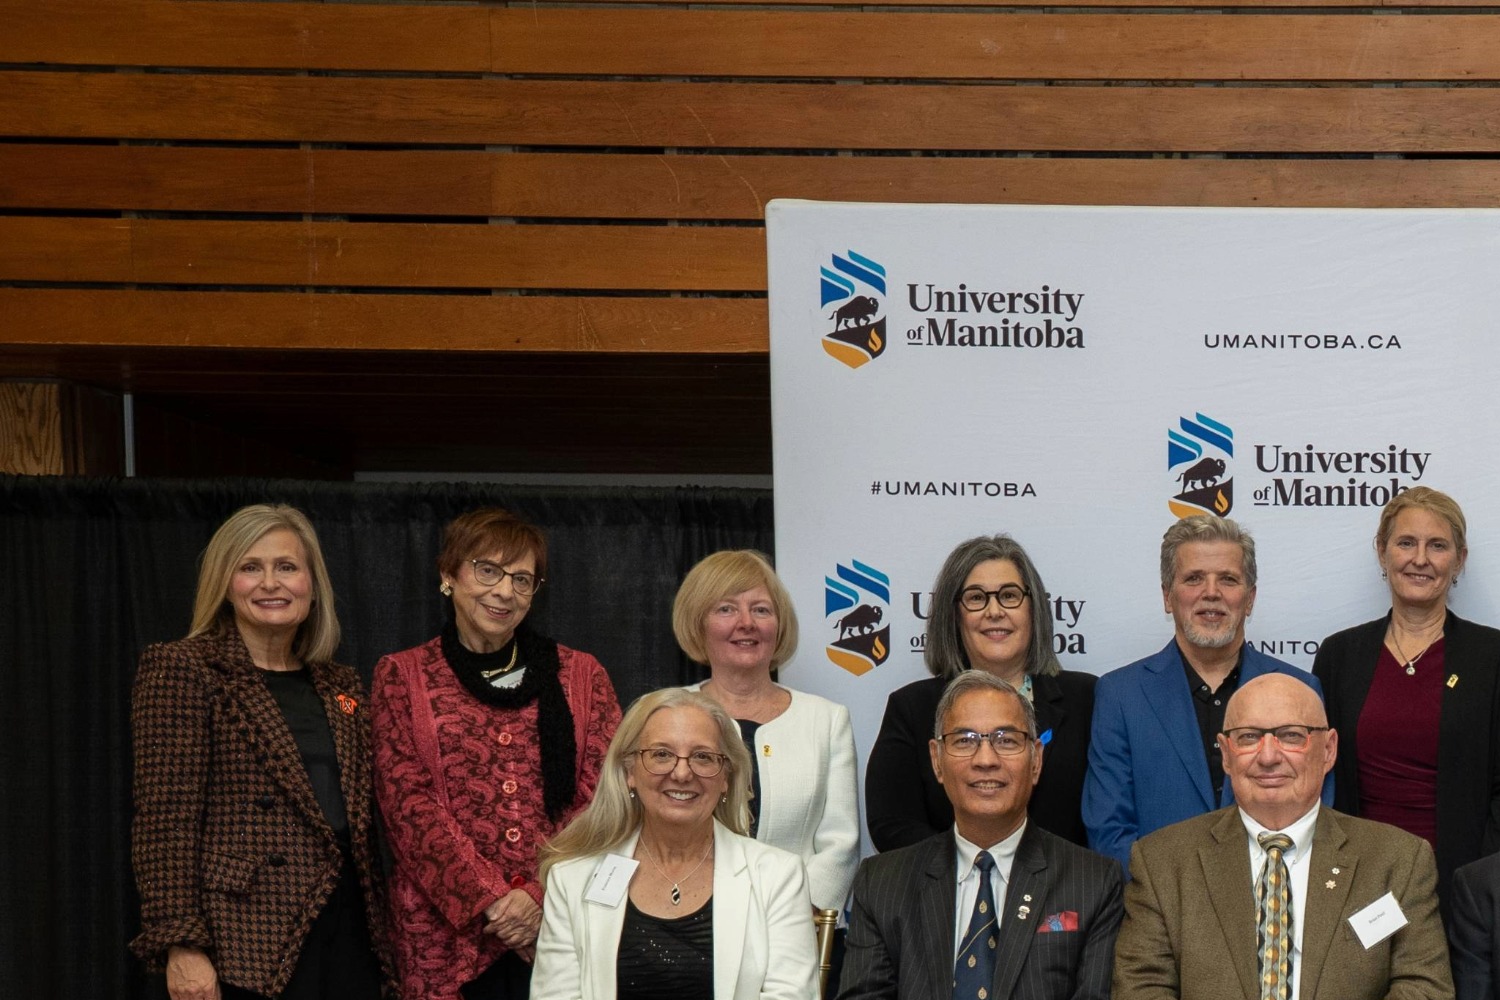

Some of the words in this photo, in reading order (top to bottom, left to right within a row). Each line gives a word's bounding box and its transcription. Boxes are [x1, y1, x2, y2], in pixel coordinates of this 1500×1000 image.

[906, 282, 1086, 321] University
[906, 325, 925, 345] of
[926, 316, 1086, 349] Manitoba
[1203, 334, 1402, 350] UMANITOBA.CA
[1254, 443, 1432, 481] University
[870, 480, 1038, 498] #UMANITOBA
[1253, 486, 1272, 506] of
